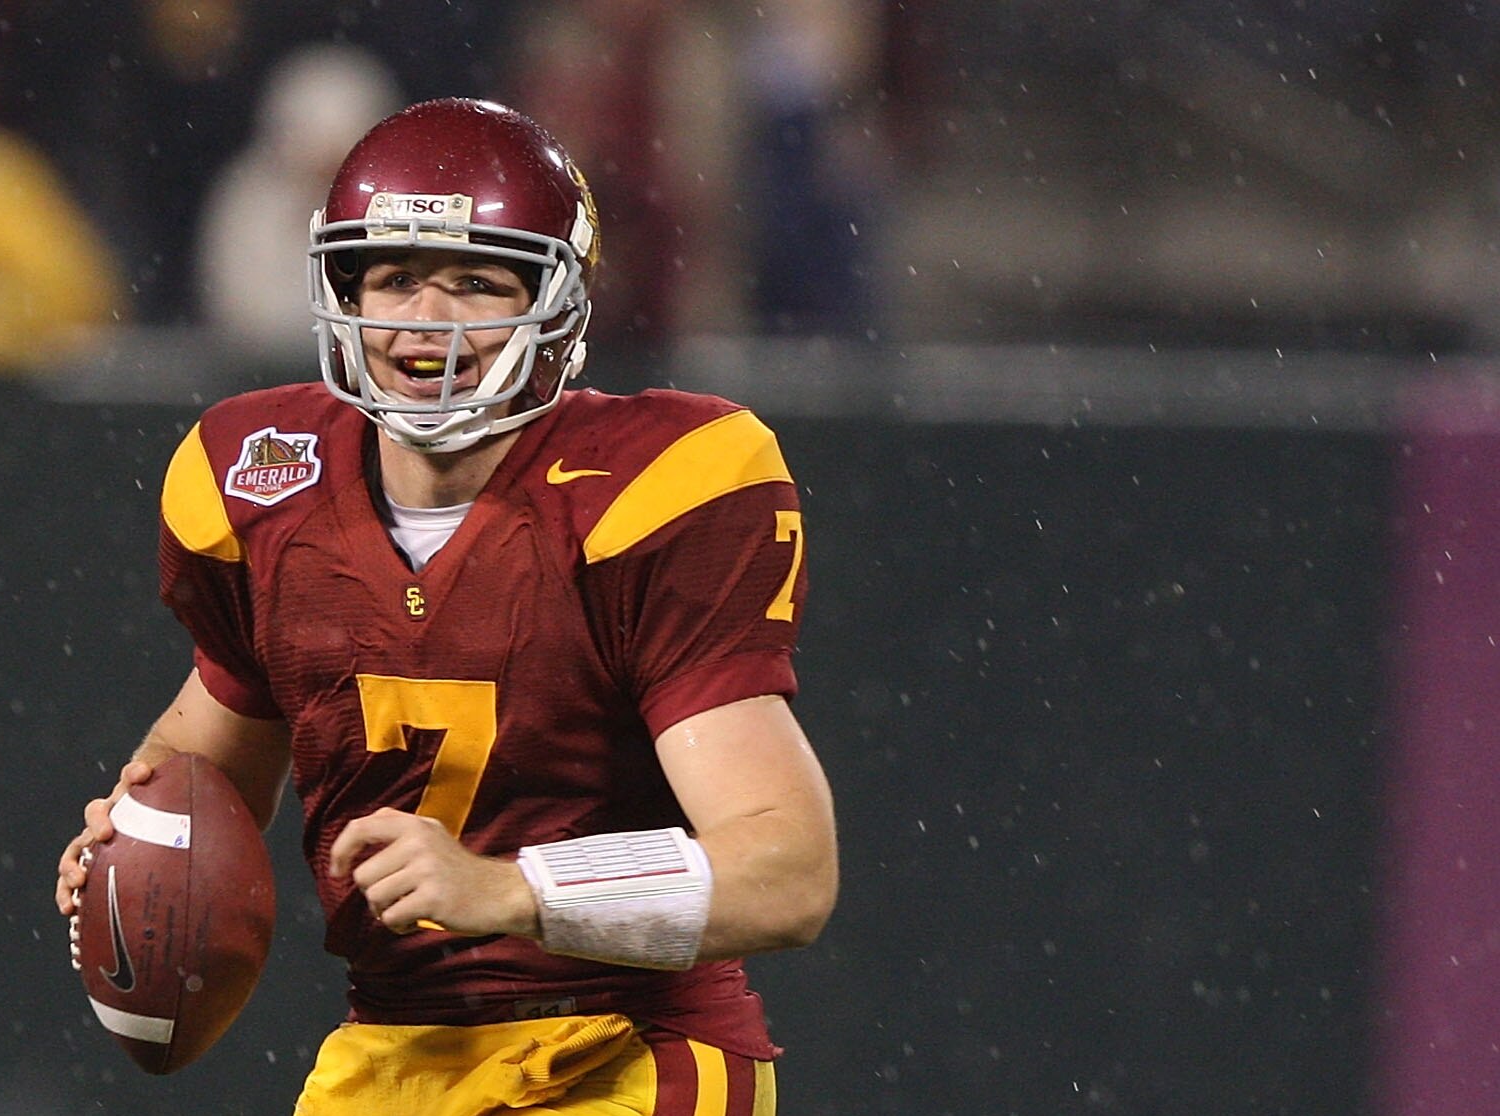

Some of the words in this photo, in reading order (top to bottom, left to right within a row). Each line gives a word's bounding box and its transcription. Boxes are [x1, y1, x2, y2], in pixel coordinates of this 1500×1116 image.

[237, 466, 308, 486] EMERALD
[766, 511, 803, 623] 7
[356, 674, 497, 931] 7
